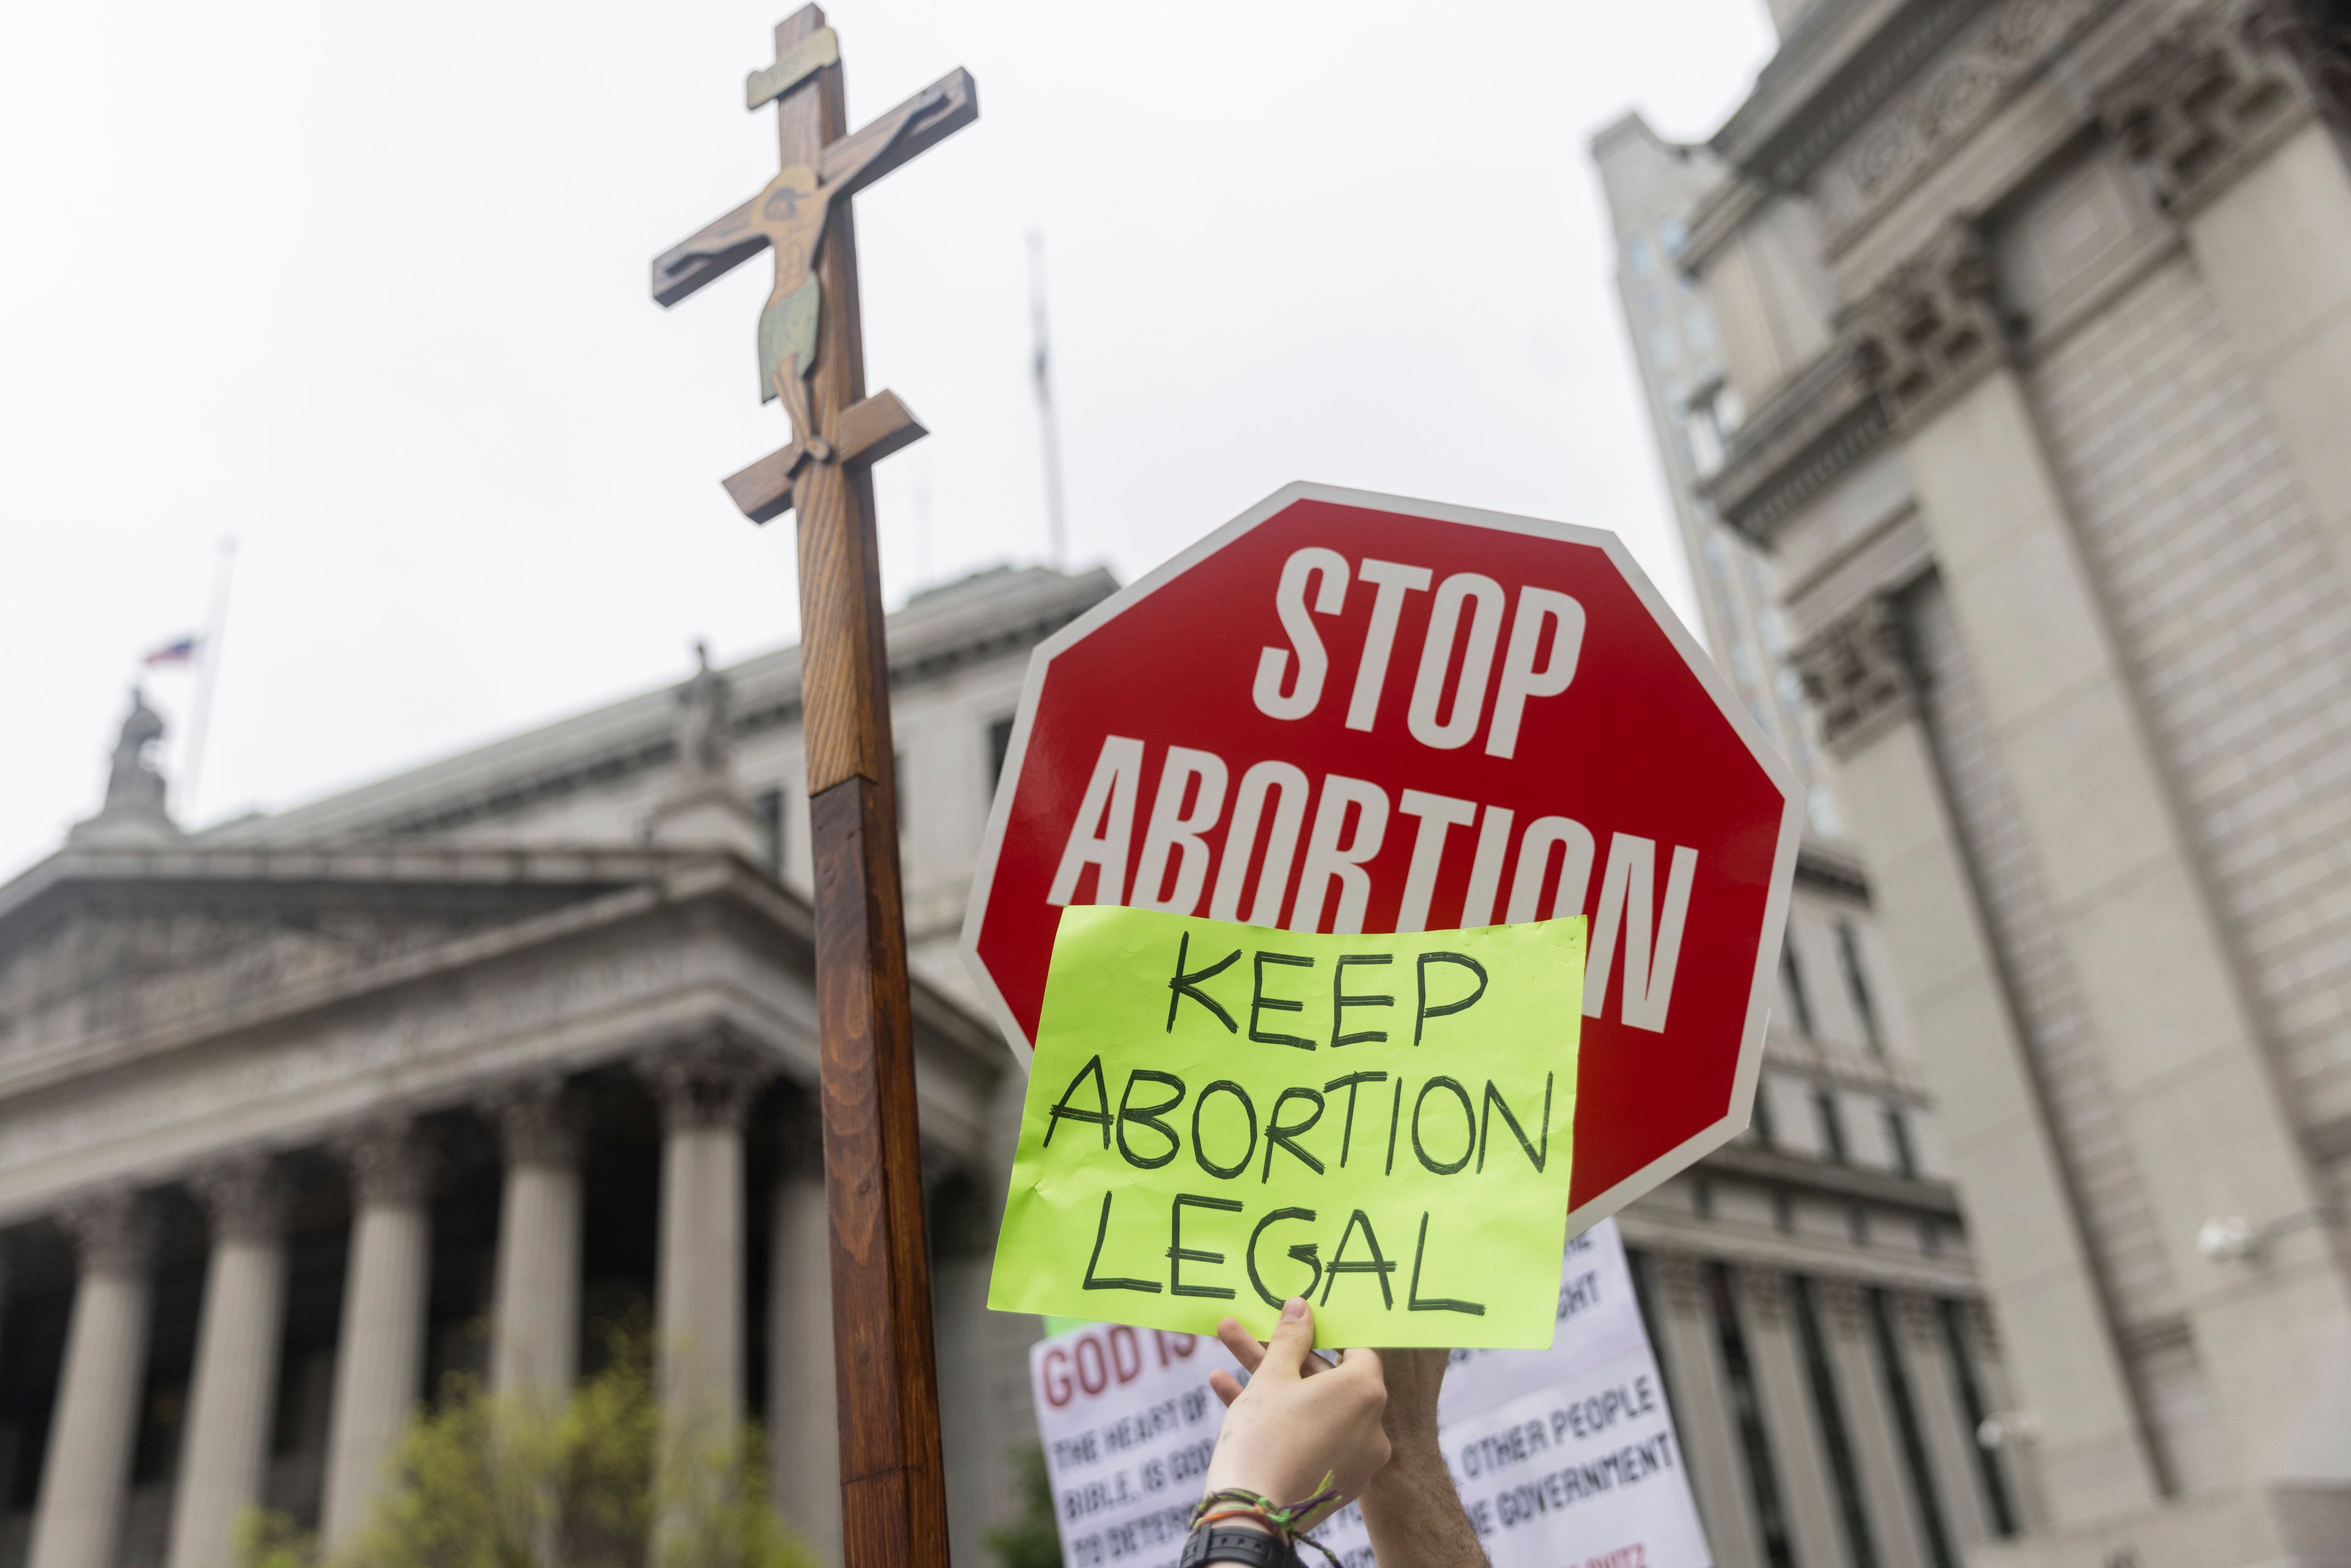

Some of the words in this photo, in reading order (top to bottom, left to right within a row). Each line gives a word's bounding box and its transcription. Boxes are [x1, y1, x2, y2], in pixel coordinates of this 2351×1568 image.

[1251, 546, 1587, 760] STOP
[1046, 733, 1699, 1033] ABORTION
[1167, 931, 1488, 1051] KEEP
[1043, 1054, 1553, 1184] ABORTION
[1082, 1190, 1487, 1316] LEGAL
[1042, 1322, 1142, 1409] GOD
[1051, 1428, 1099, 1468] THE
[1102, 1397, 1180, 1454] HEART
[1180, 1385, 1210, 1427] OF
[1139, 1458, 1167, 1494] IS
[1461, 1419, 1550, 1480] OTHER
[1550, 1374, 1655, 1445] PEOPLE
[1496, 1430, 1674, 1527] GOVERNMENT
[1072, 1533, 1104, 1568] TO
